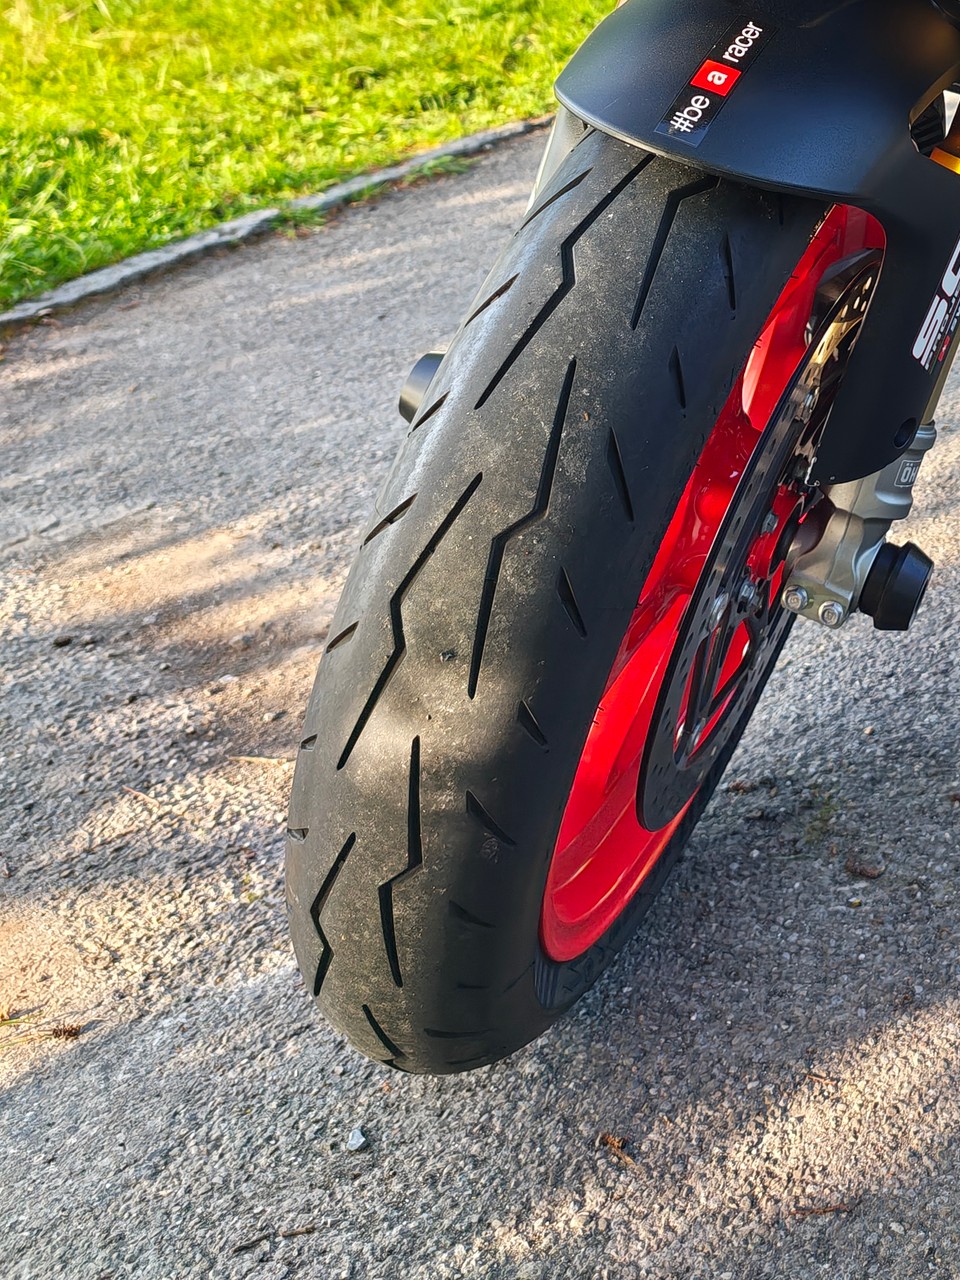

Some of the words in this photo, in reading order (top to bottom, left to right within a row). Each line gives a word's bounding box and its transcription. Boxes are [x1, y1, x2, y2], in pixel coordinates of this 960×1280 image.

[670, 95, 710, 132] #be
[707, 70, 728, 86] a
[722, 21, 763, 63] racer
